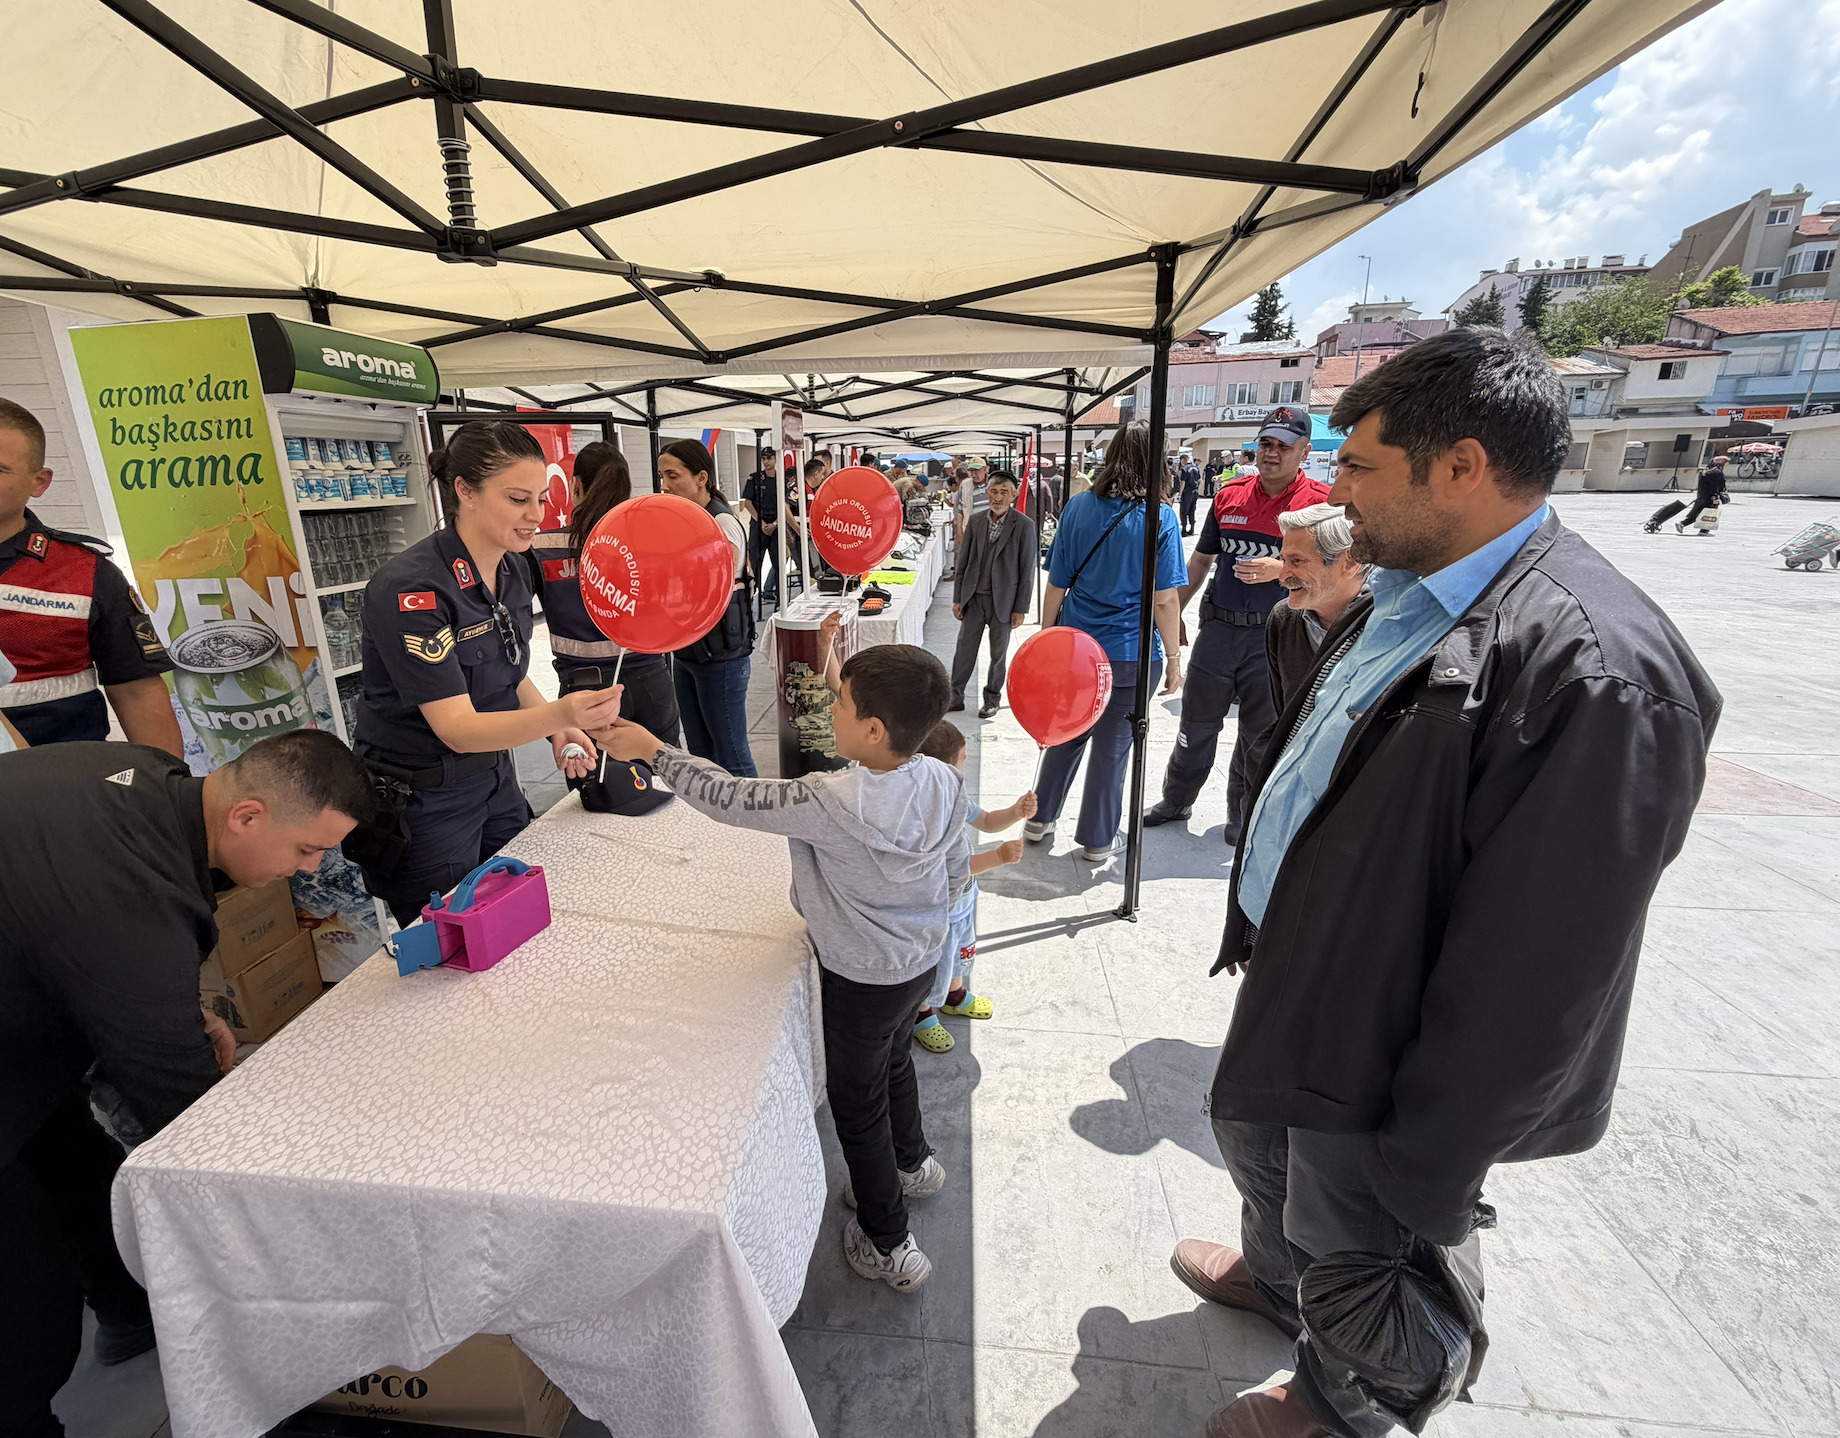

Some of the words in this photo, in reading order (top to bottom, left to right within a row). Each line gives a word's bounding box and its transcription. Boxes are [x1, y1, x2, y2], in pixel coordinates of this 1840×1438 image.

[321, 347, 416, 380] aroma
[109, 413, 254, 452] başkasını
[119, 452, 264, 491] arama
[820, 515, 872, 539] JANDARMA
[825, 499, 848, 515] KANUN
[849, 499, 872, 526] ORDUSU
[580, 547, 637, 617] JANDARMA
[590, 534, 620, 549] KANUN
[619, 545, 640, 597] ORDUSU
[2, 593, 76, 611] JANDARMA
[187, 694, 309, 731] aroma
